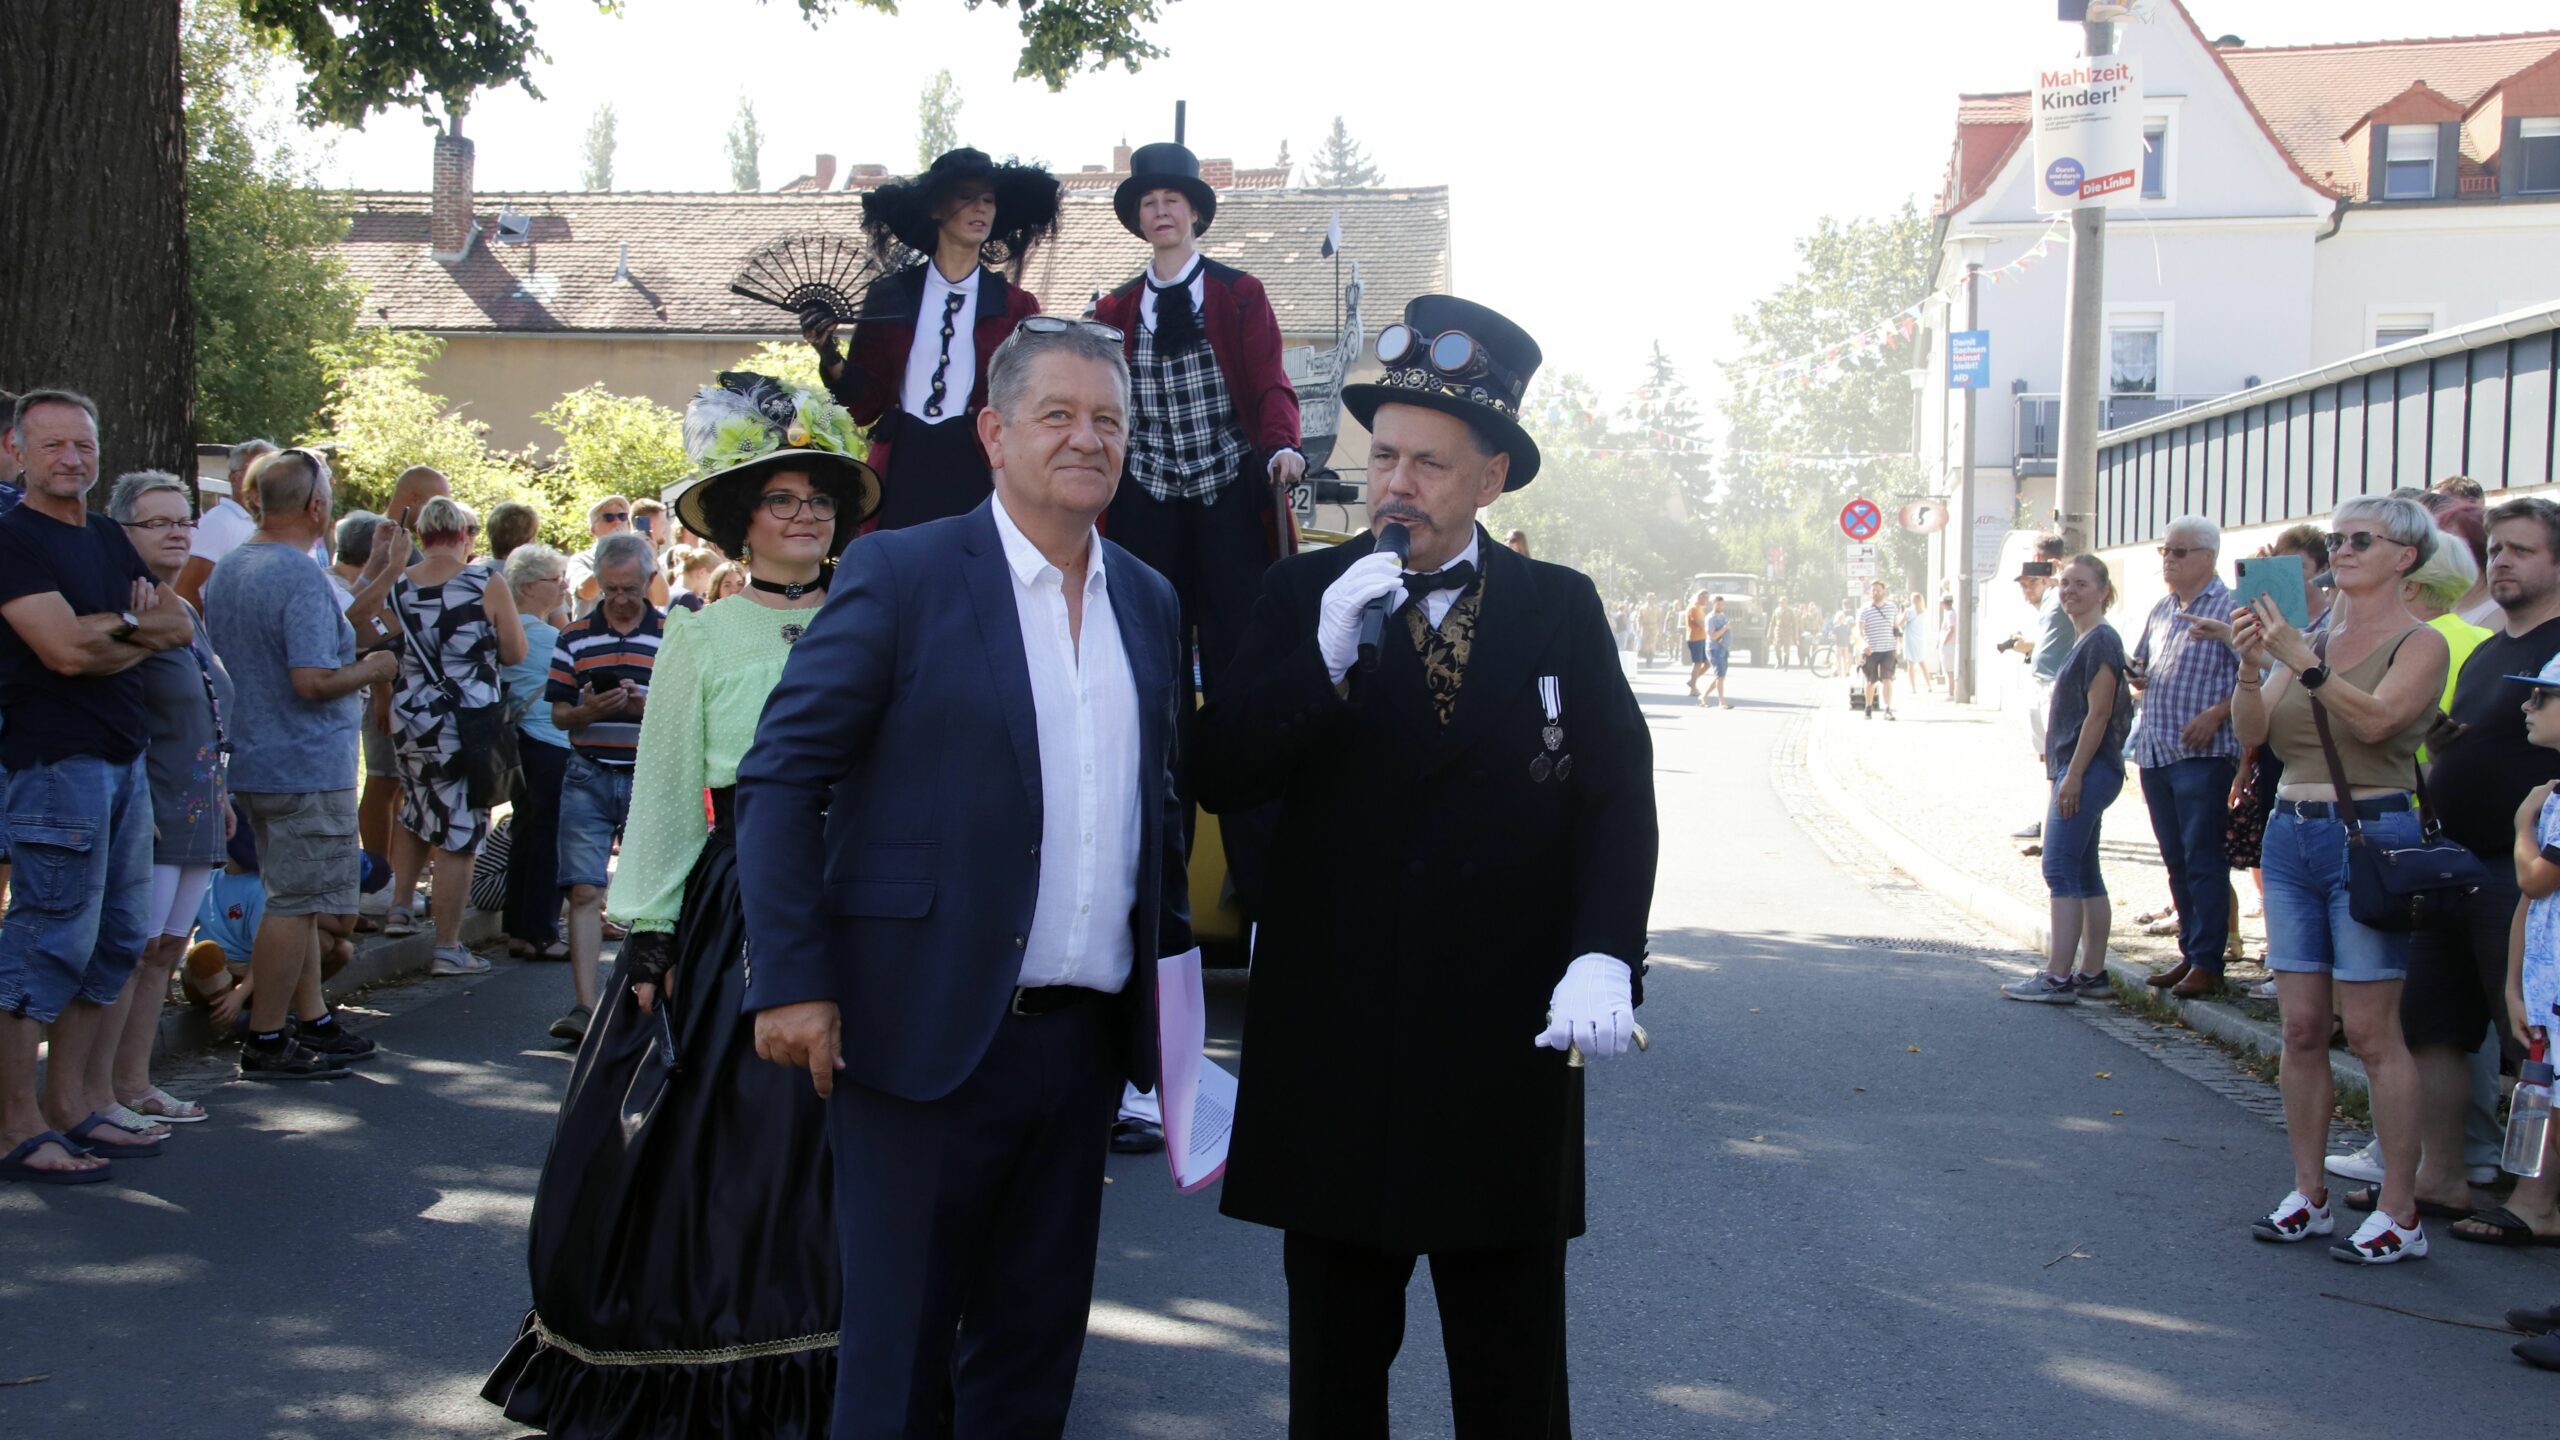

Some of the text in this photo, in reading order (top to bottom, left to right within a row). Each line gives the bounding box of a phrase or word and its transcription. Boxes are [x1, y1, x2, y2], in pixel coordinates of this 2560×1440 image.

[2041, 63, 2134, 89] Mahlzeit,
[2083, 176, 2132, 196] Die Linke
[1952, 338, 1976, 346] Damit
[1952, 346, 1987, 354] Sachsen
[1953, 373, 1969, 382] AfD
